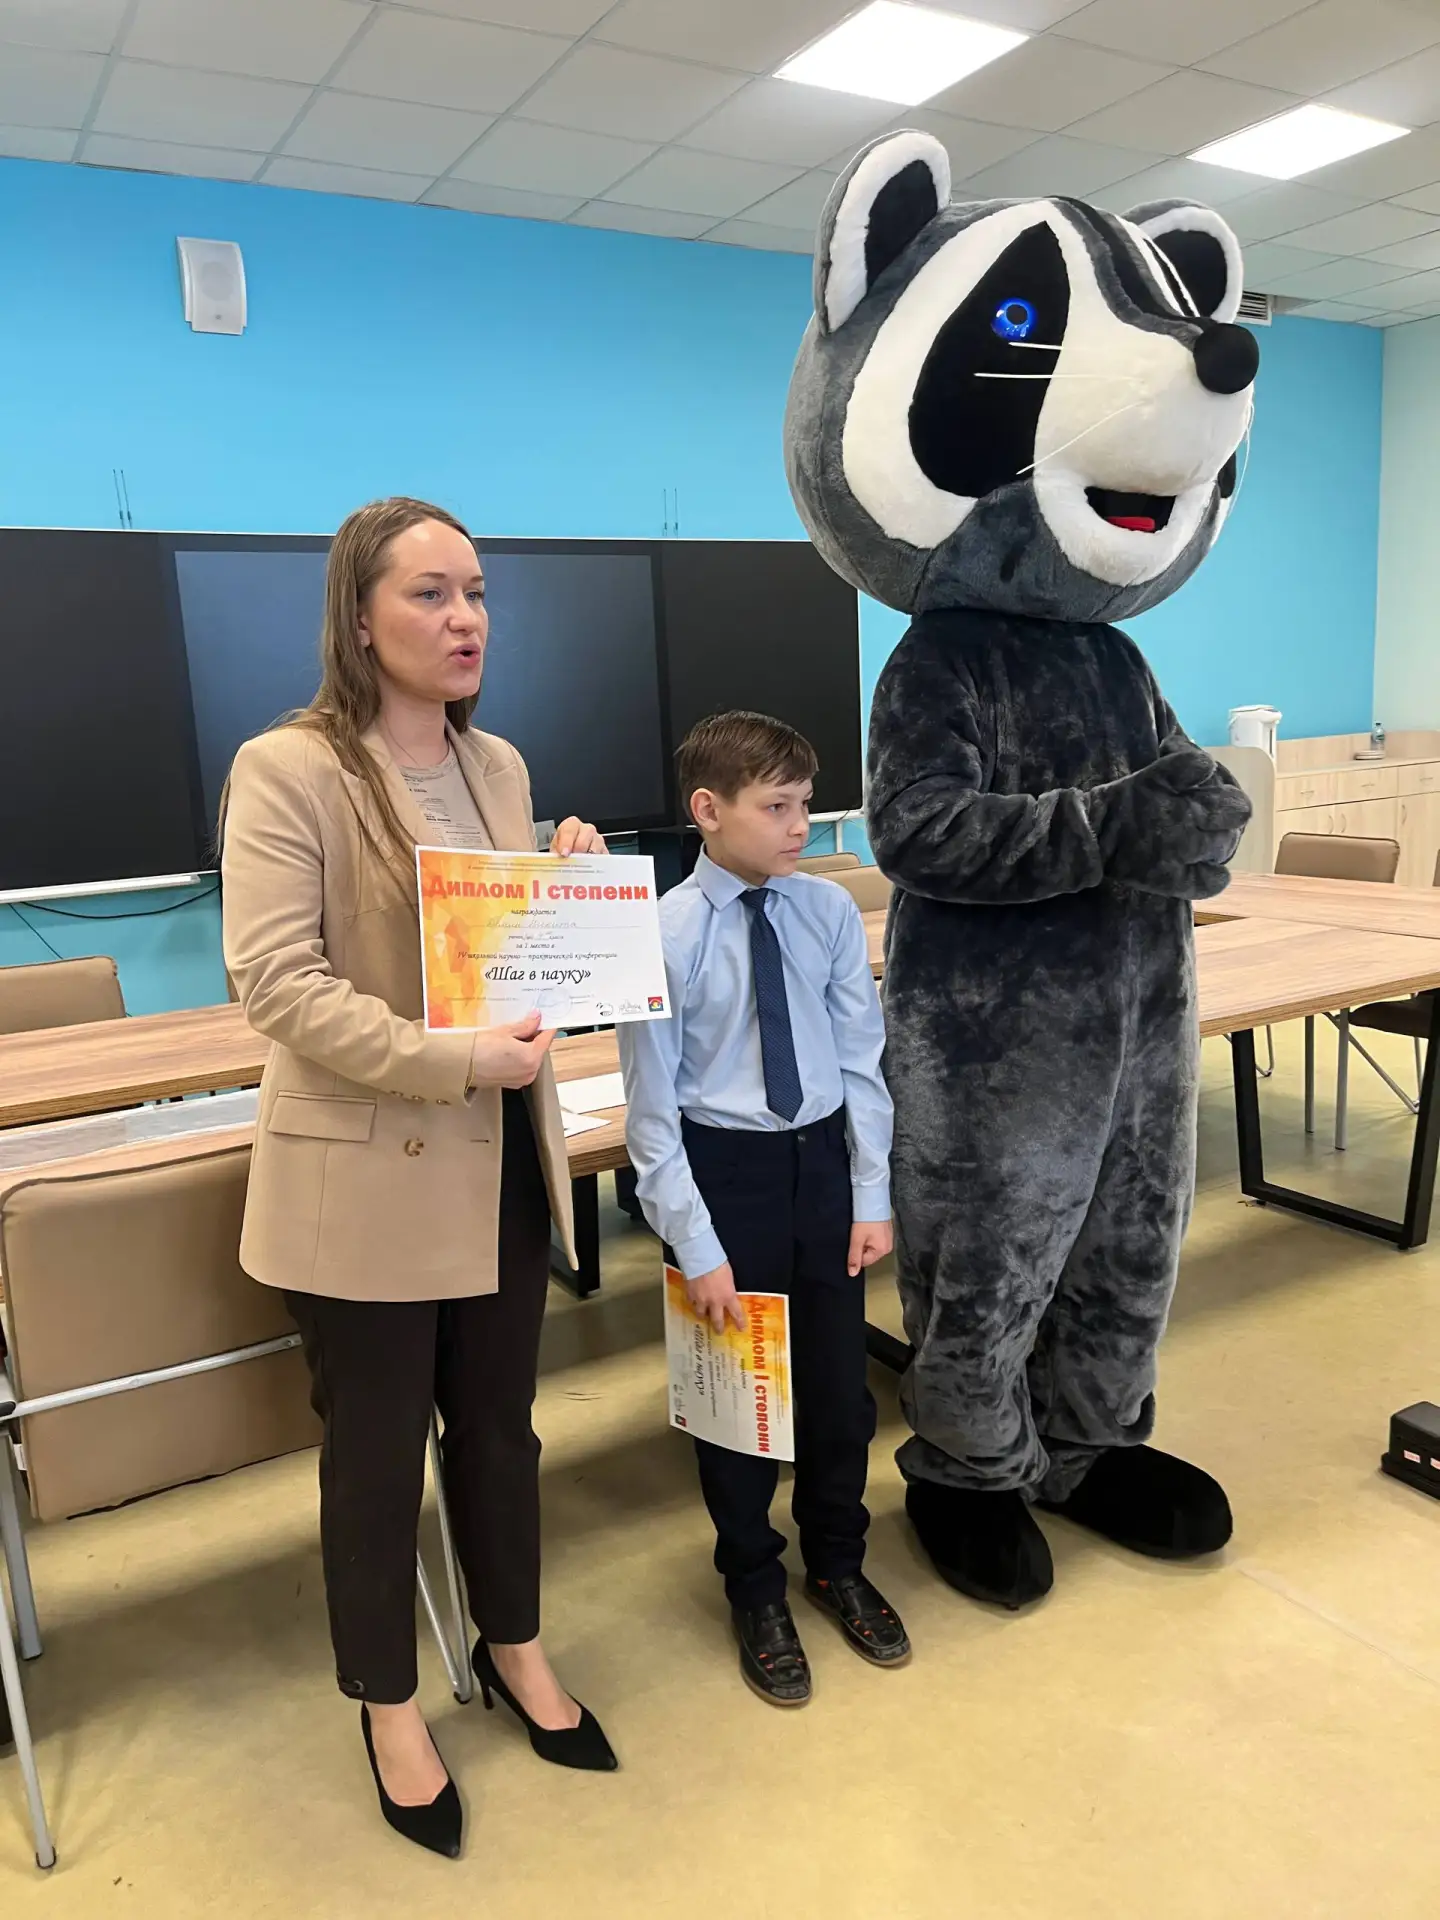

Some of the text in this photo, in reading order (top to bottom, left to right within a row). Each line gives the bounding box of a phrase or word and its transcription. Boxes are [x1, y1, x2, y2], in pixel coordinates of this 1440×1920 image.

[426, 875, 525, 899] Диплом
[547, 883, 649, 900] степени
[485, 966, 591, 985] «Шаг в науку»
[748, 1302, 767, 1371] Диплом
